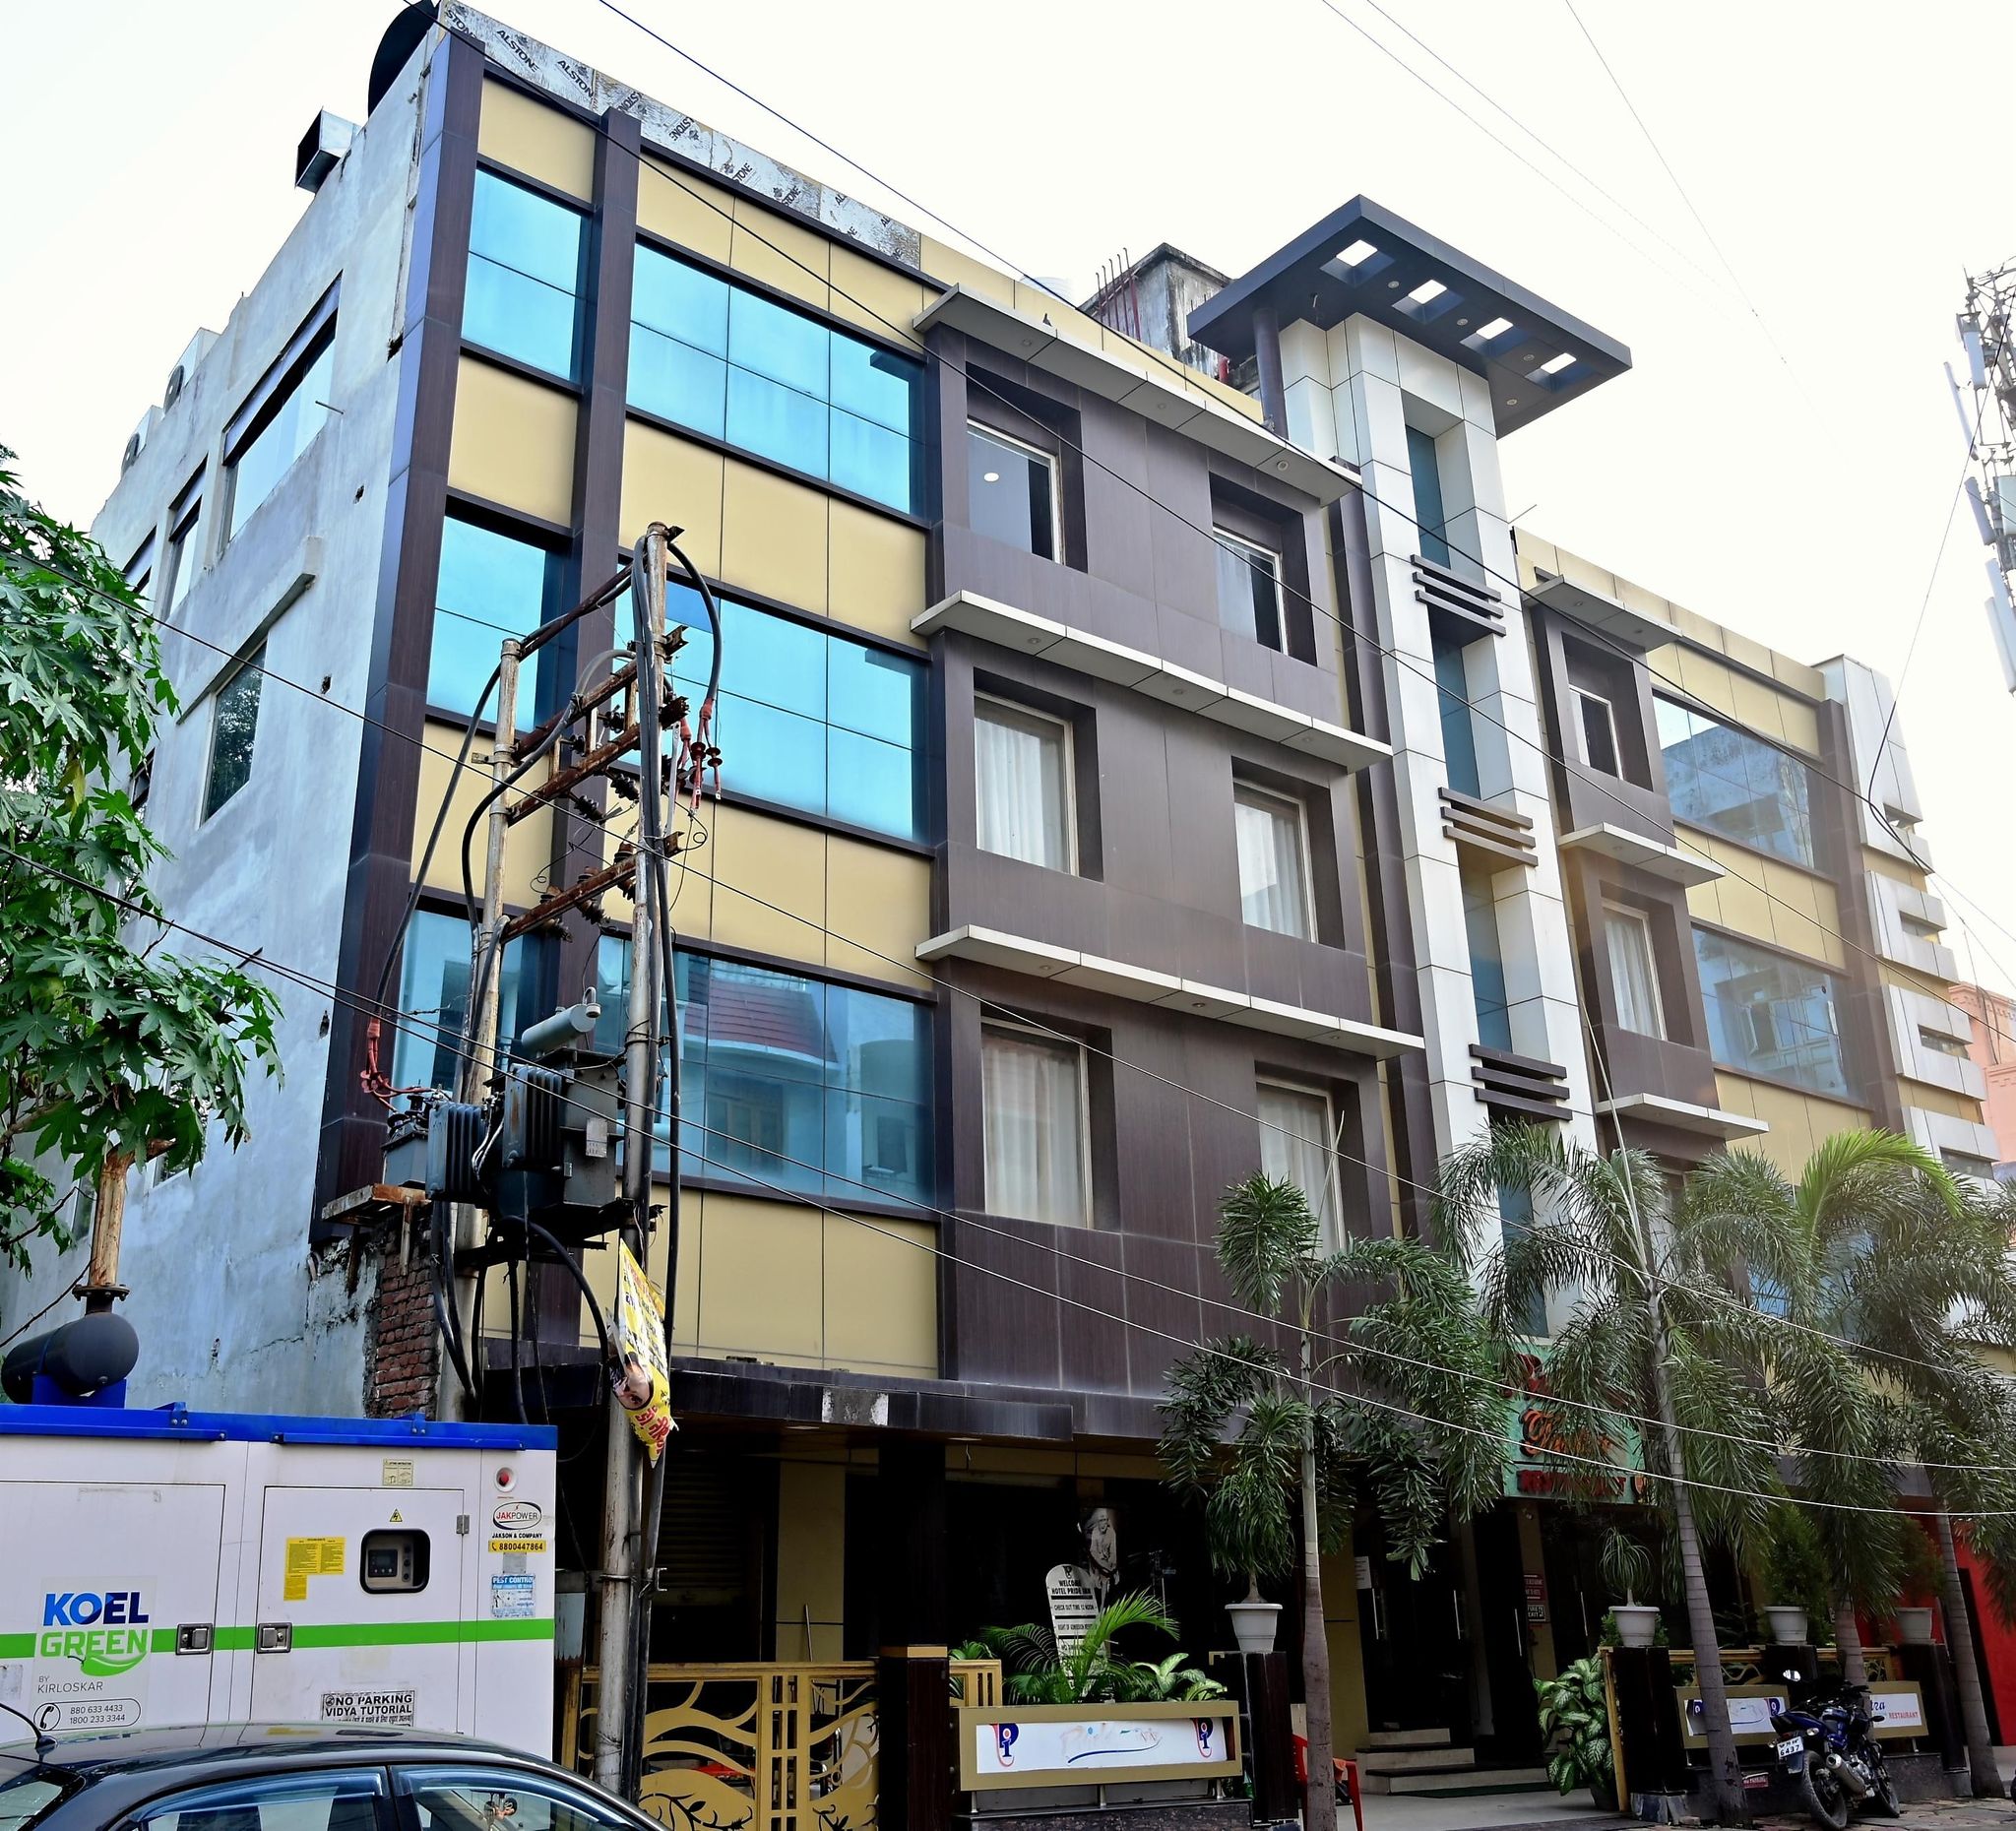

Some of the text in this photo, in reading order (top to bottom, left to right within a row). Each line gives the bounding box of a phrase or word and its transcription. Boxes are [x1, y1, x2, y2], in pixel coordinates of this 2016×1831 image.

[497, 30, 539, 73] ALSTONE
[42, 1591, 150, 1626] KOEL
[40, 1629, 148, 1658] GREEN
[37, 1681, 103, 1693] KIRLOSKAR
[336, 1694, 412, 1706] NO PARKING
[70, 1704, 123, 1715] 880 633 4433
[325, 1704, 412, 1717] VIDYA TUTORIAL
[70, 1714, 126, 1725] 1800 233 3344
